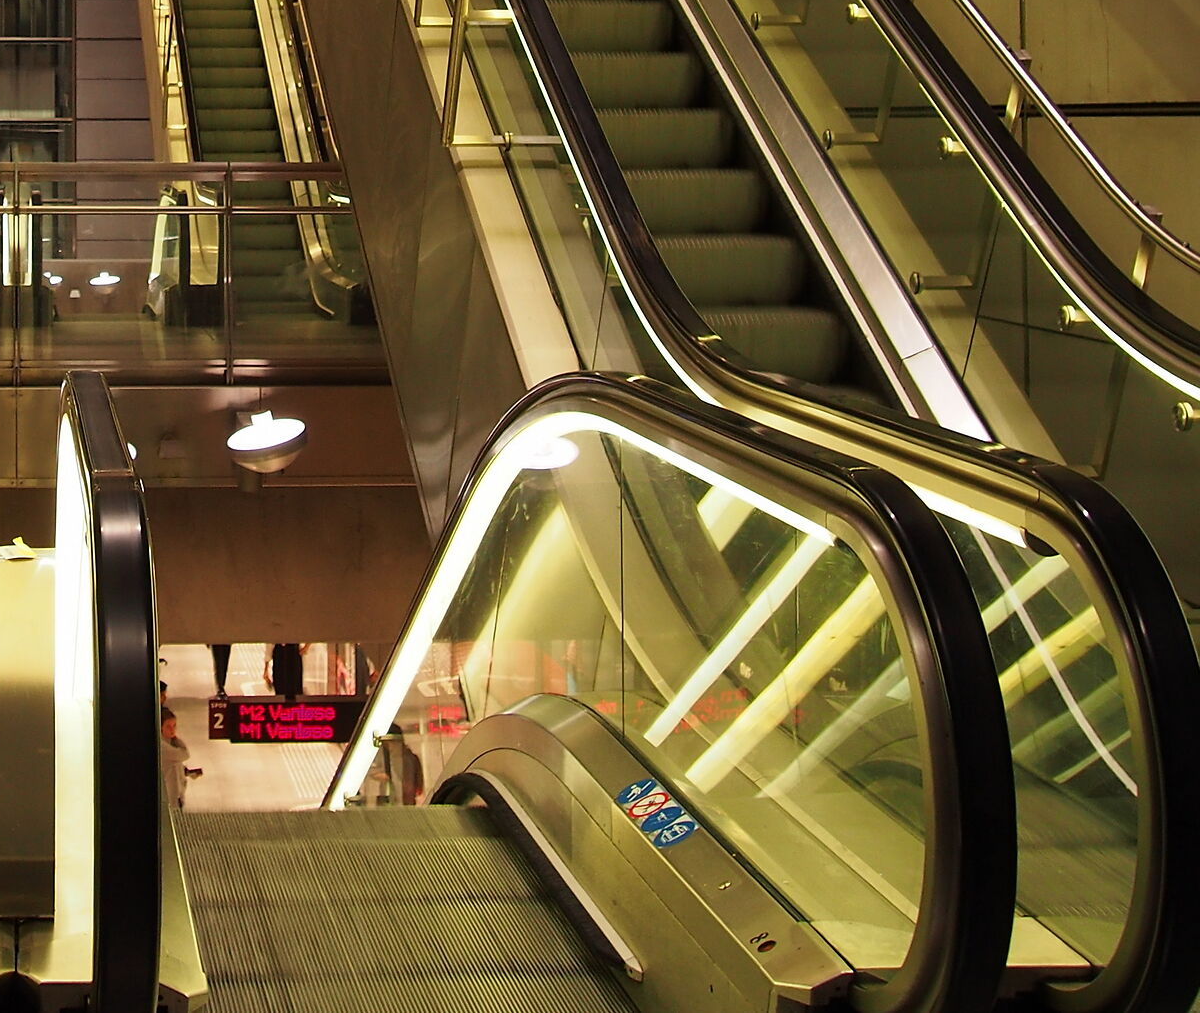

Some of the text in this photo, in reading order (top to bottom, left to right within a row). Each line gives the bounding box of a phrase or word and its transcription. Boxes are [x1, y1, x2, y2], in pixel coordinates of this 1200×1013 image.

[213, 712, 224, 729] 2
[239, 704, 266, 722] M2
[239, 722, 261, 740] M1
